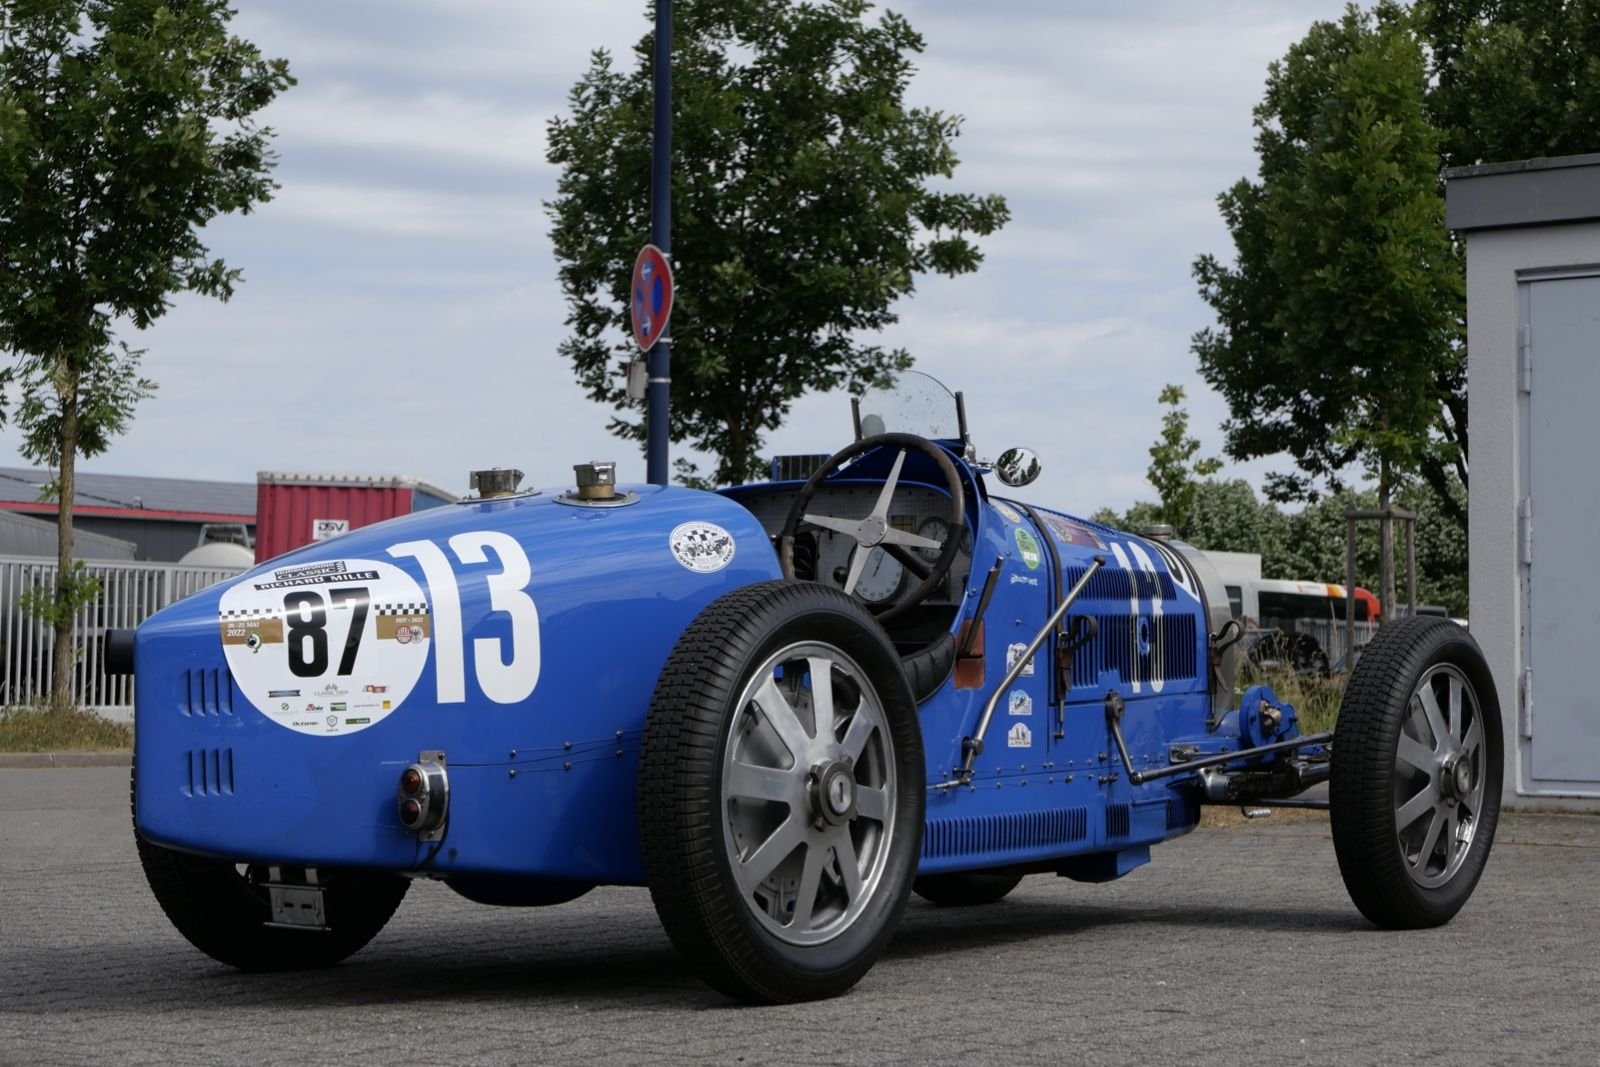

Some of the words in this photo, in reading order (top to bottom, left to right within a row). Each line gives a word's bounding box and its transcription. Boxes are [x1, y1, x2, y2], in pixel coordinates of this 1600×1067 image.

[318, 522, 344, 531] DSV
[277, 567, 336, 579] CLASSIC
[260, 577, 323, 590] RICHARD
[331, 572, 373, 581] MILLE
[385, 531, 541, 704] 13
[227, 629, 246, 637] 2022
[283, 587, 370, 677] 87
